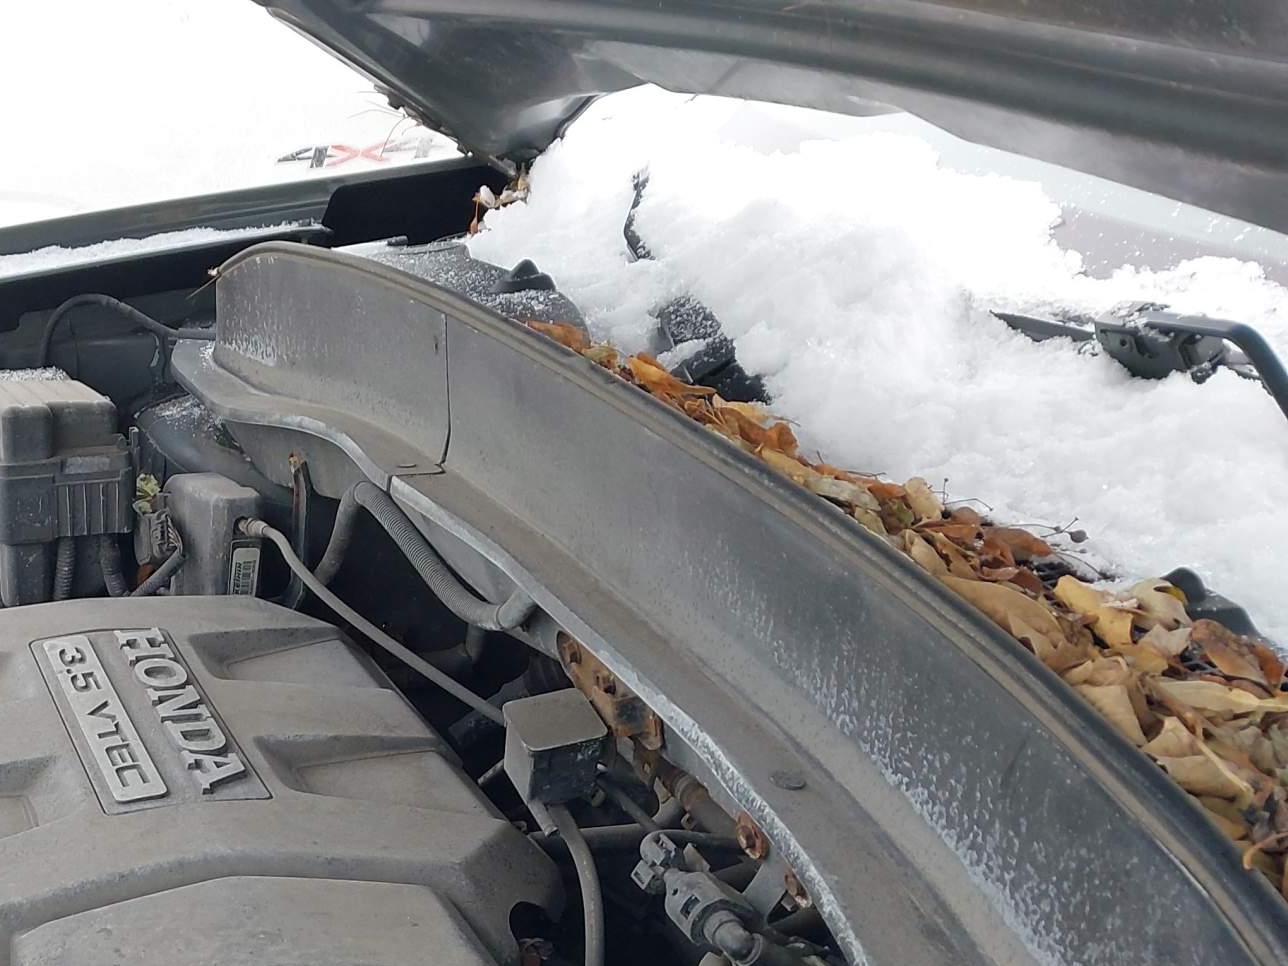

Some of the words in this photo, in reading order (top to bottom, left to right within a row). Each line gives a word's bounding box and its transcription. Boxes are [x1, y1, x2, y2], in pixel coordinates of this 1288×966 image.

[58, 646, 102, 693] 3.5
[86, 700, 151, 788] VTEC
[114, 627, 248, 795] HONDA
